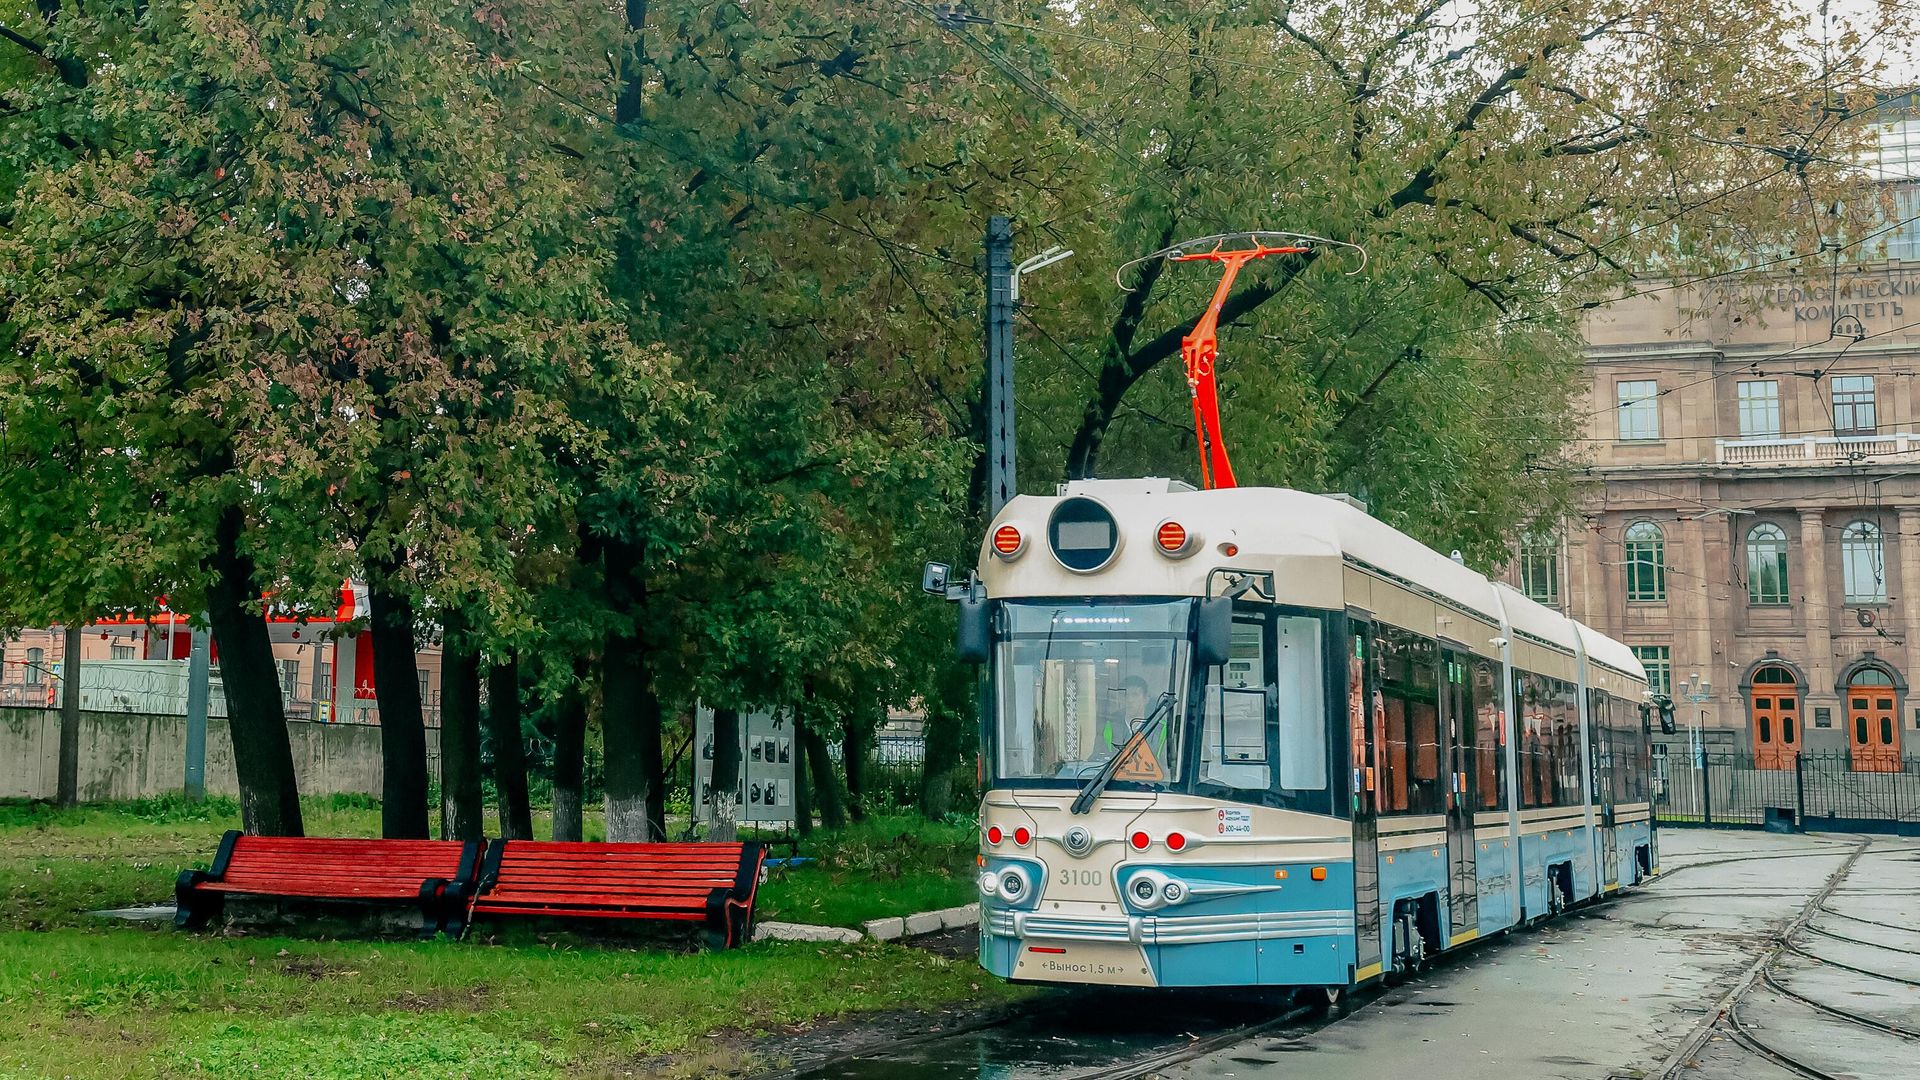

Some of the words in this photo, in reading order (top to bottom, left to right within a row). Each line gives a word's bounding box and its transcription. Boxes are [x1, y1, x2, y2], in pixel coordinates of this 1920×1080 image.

[1795, 301, 1903, 321] КОМИТЕТЪ
[1060, 869, 1102, 886] 3100
[1049, 960, 1087, 973] Вынос
[1089, 963, 1104, 974] 1,5
